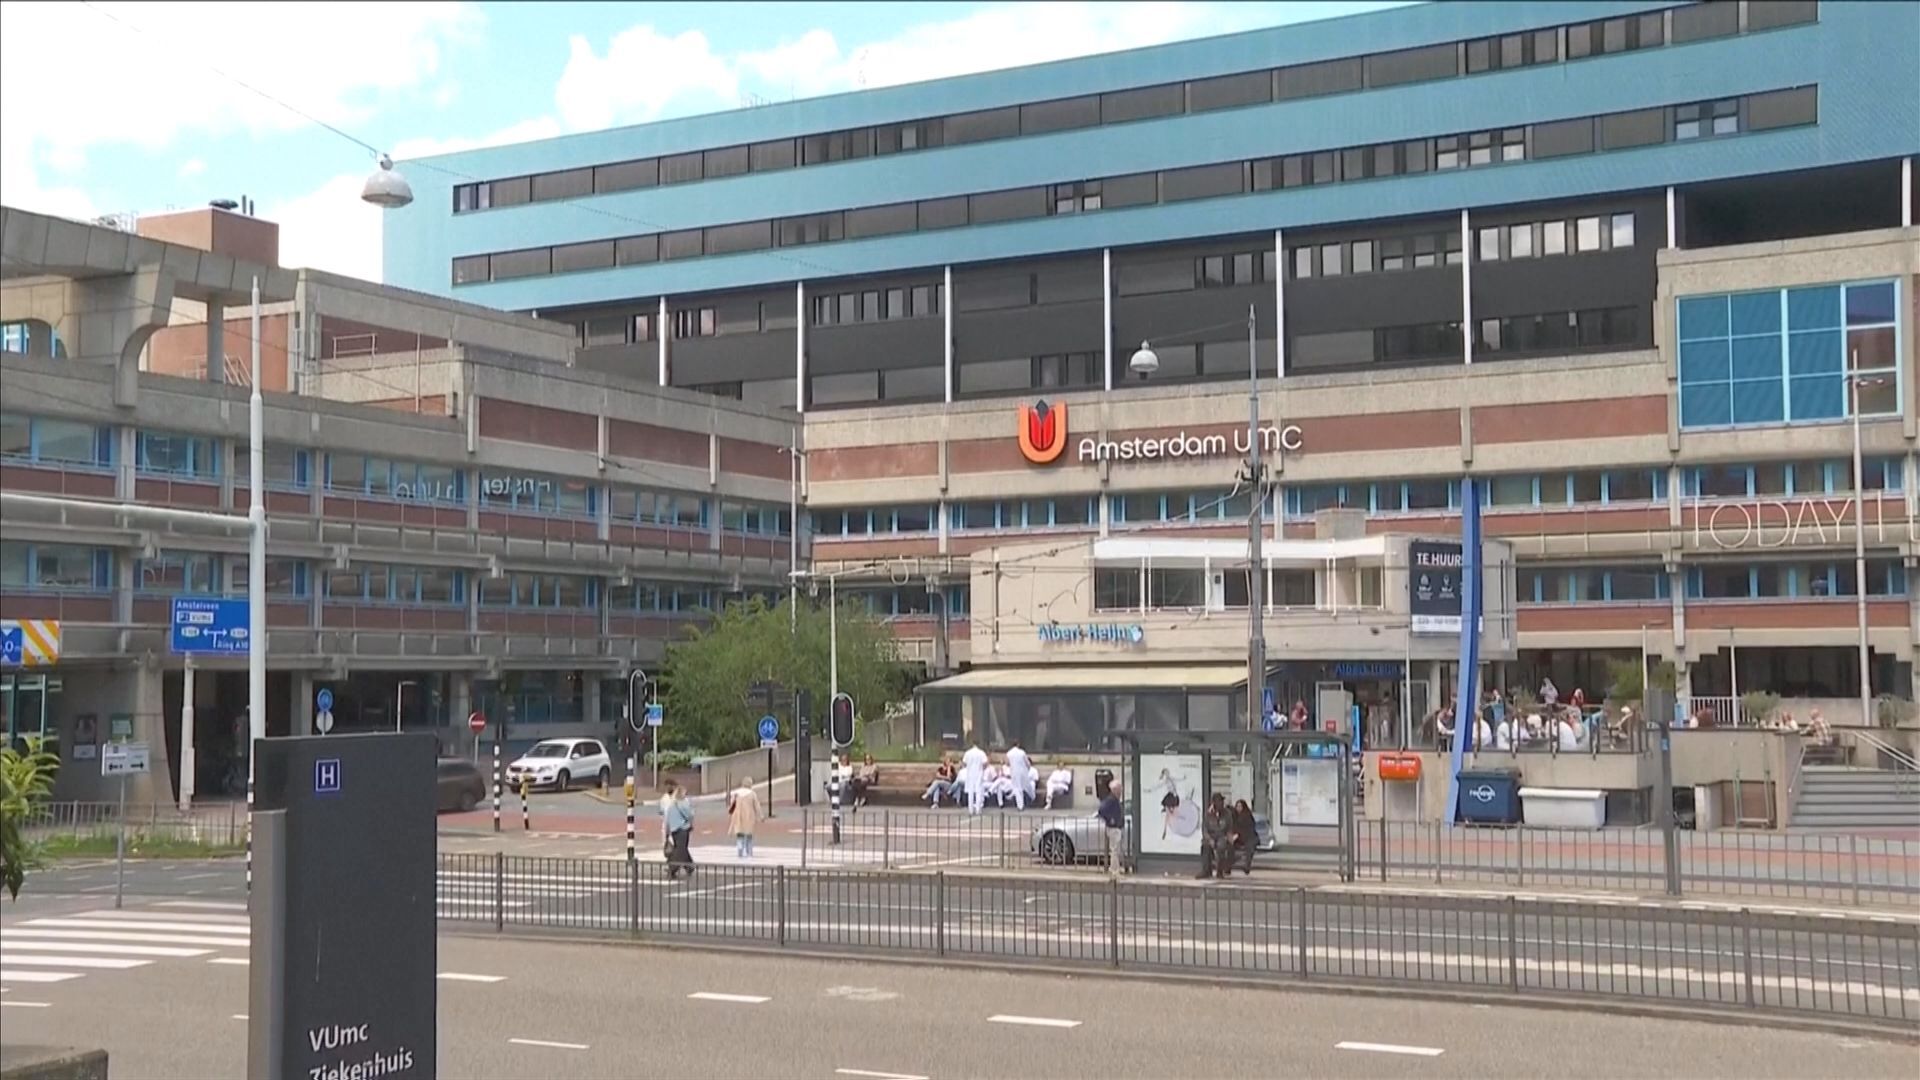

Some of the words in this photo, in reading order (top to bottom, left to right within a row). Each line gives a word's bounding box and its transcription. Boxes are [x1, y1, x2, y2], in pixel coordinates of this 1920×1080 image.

[1078, 431, 1226, 462] Amsterdam
[1416, 551, 1429, 566] TE
[308, 1023, 369, 1052] VUmc
